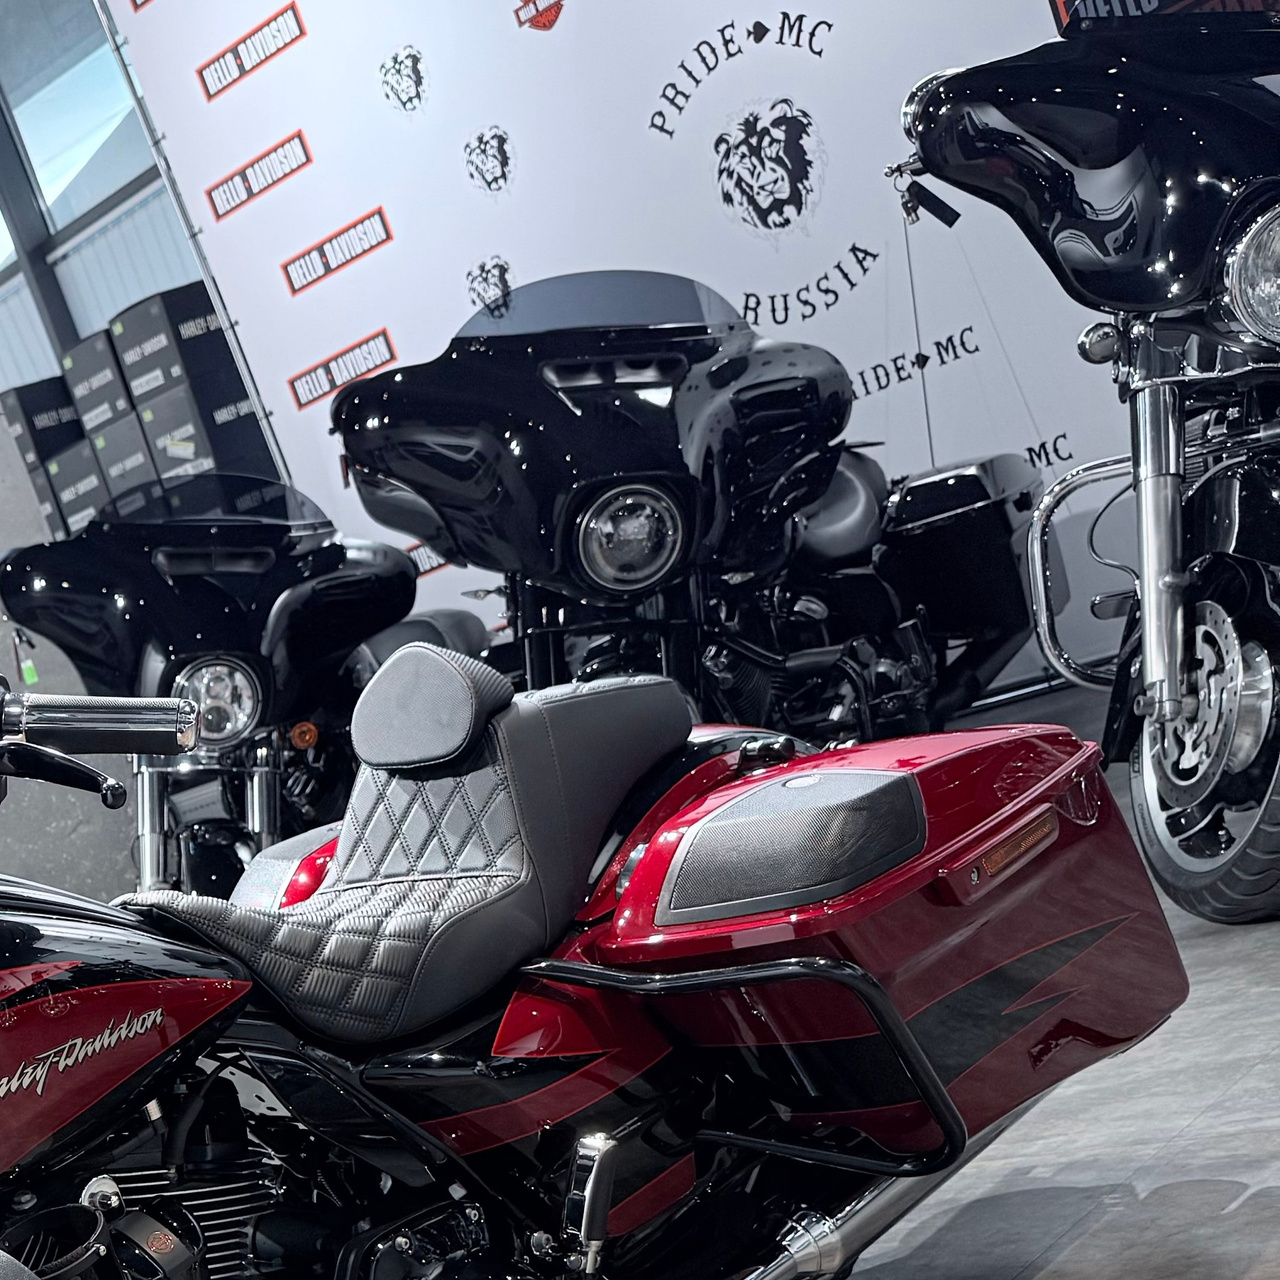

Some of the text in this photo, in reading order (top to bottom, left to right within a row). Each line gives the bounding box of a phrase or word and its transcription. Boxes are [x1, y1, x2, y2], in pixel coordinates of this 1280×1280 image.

[202, 9, 301, 95] HELLO DAVIDSON
[648, 11, 833, 140] PRIDE MC
[211, 136, 307, 216] HELLO DAVIDSON
[286, 213, 387, 290] HELLO DAVIDSON
[743, 242, 879, 326] RUSSIA
[293, 334, 392, 405] HELLO DAVIDSON
[933, 326, 980, 366] MC
[1025, 433, 1073, 468] MC
